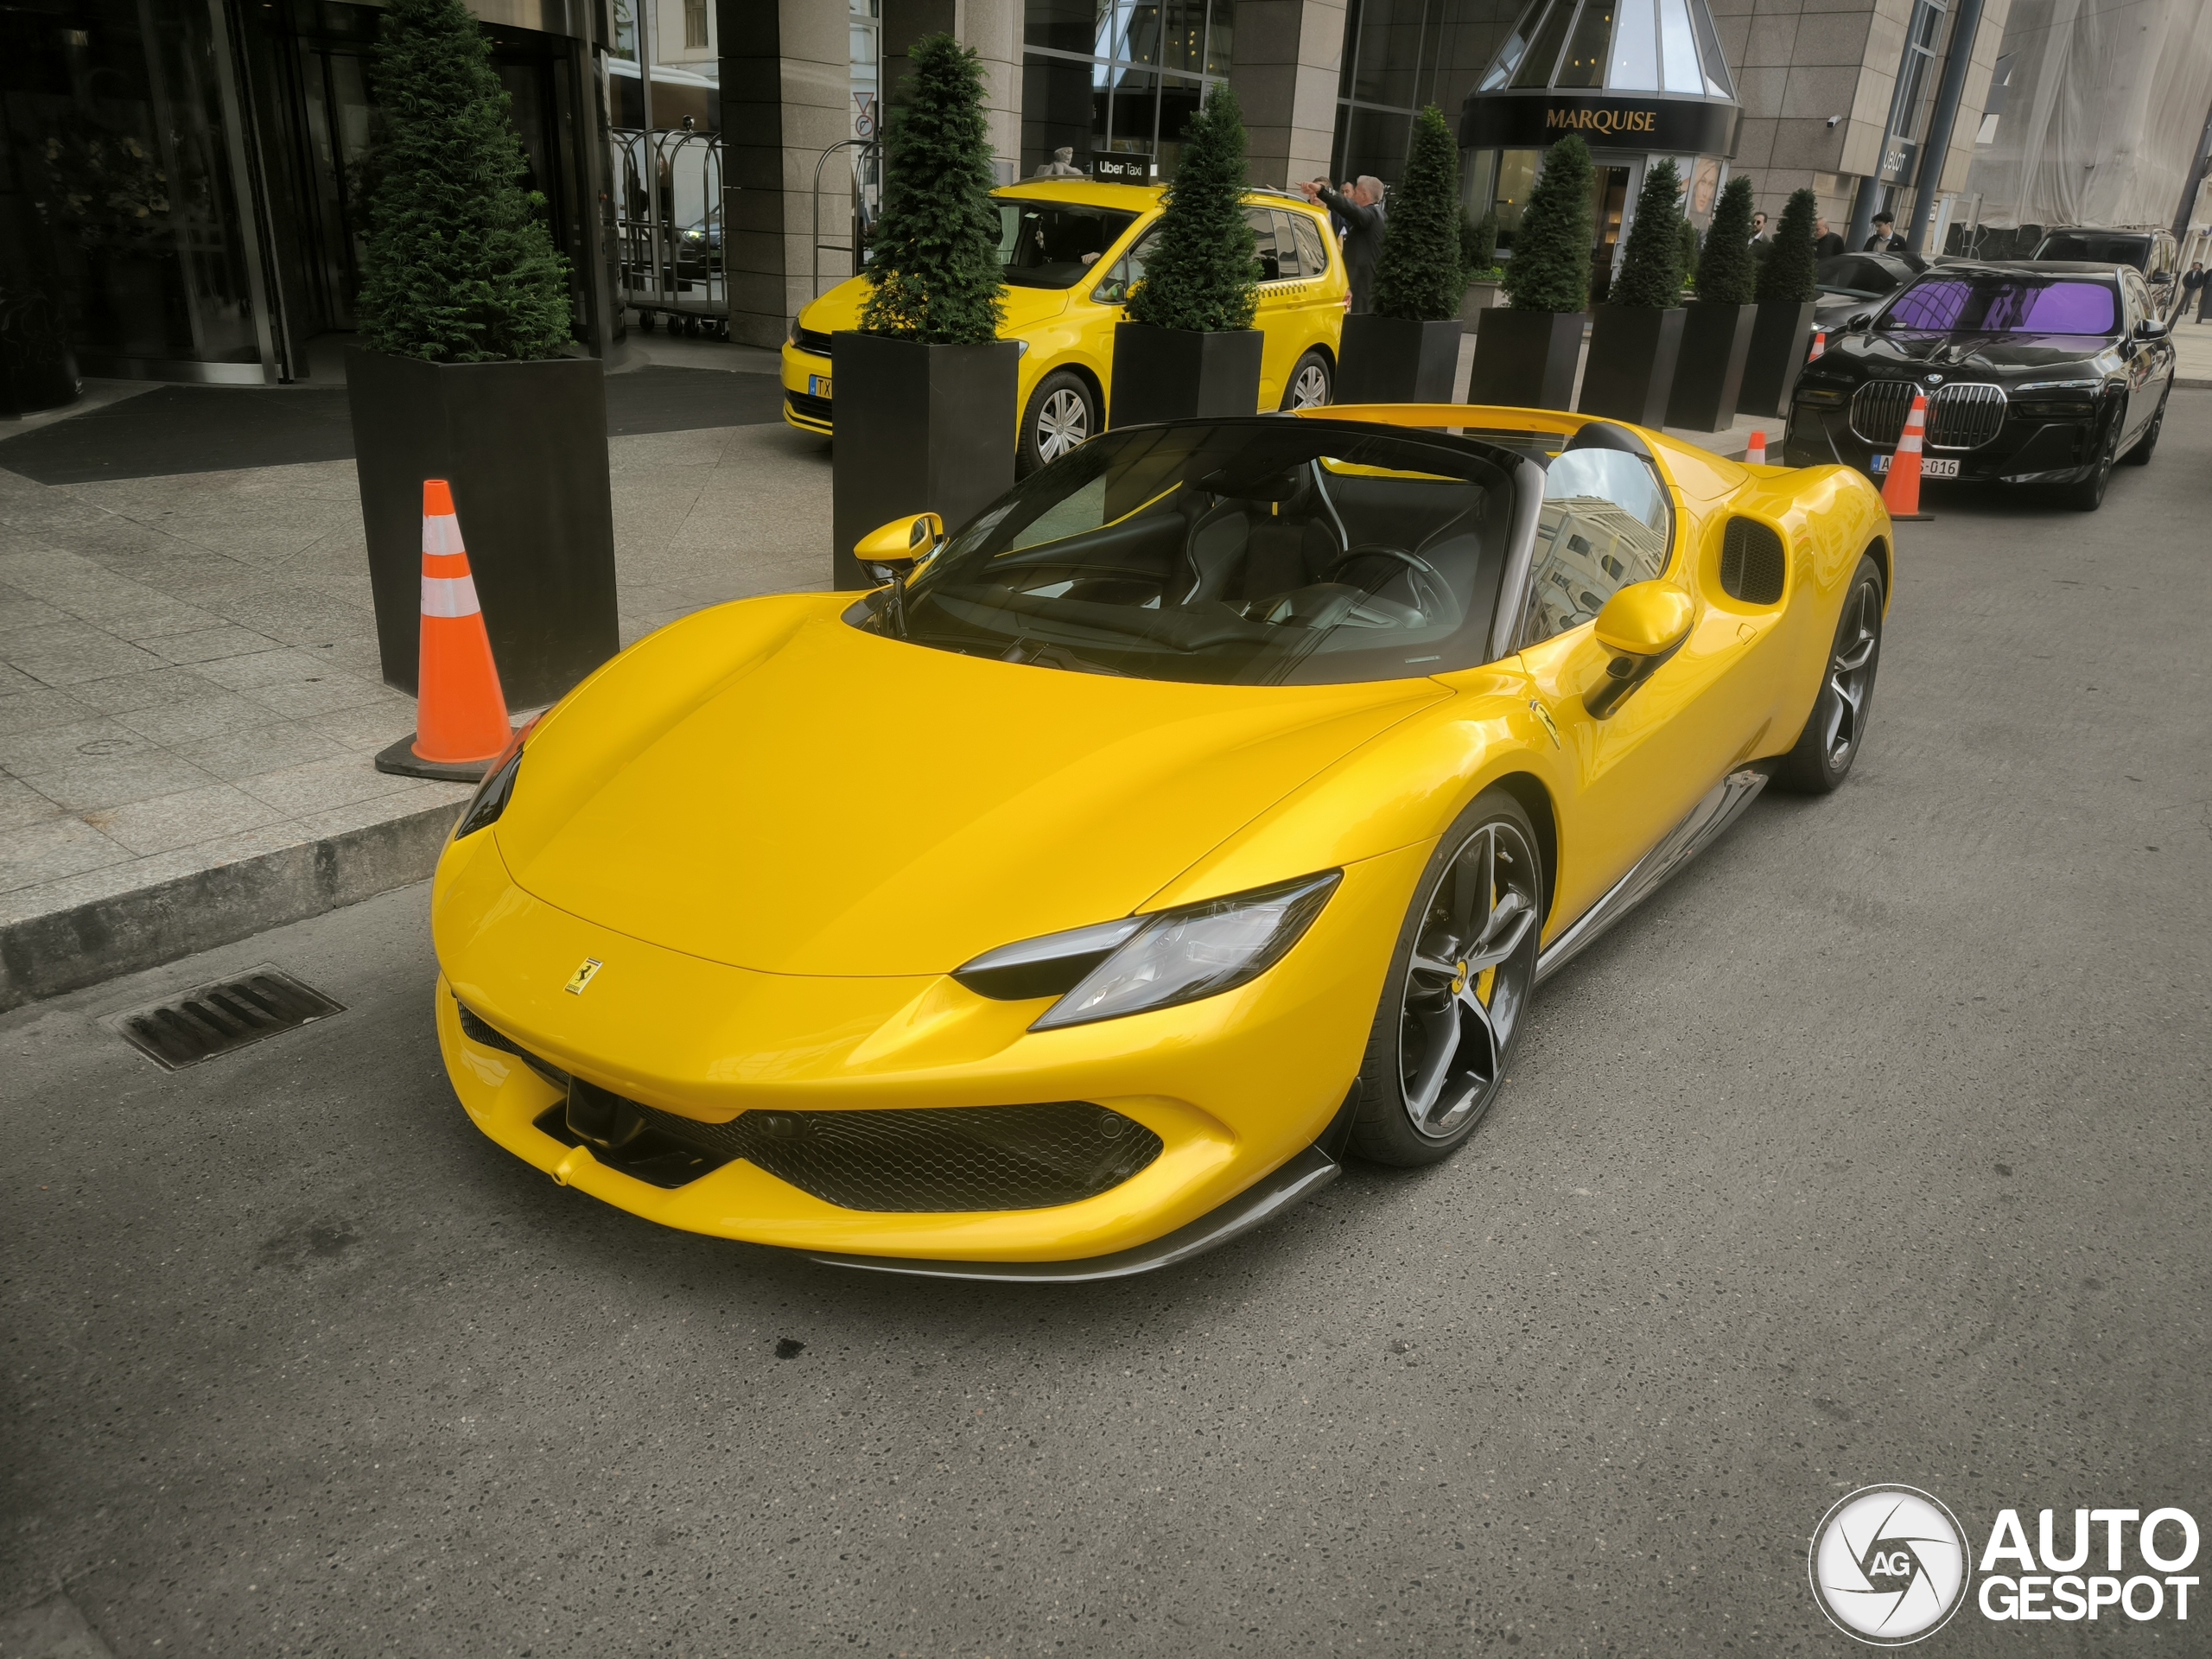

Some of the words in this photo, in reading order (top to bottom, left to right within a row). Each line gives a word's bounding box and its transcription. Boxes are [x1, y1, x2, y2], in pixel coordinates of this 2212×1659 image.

[1546, 109, 1657, 135] MARQUISE
[1099, 160, 1124, 175] Uber
[1125, 162, 1142, 176] Taxi
[1883, 149, 1906, 172] UBLOT
